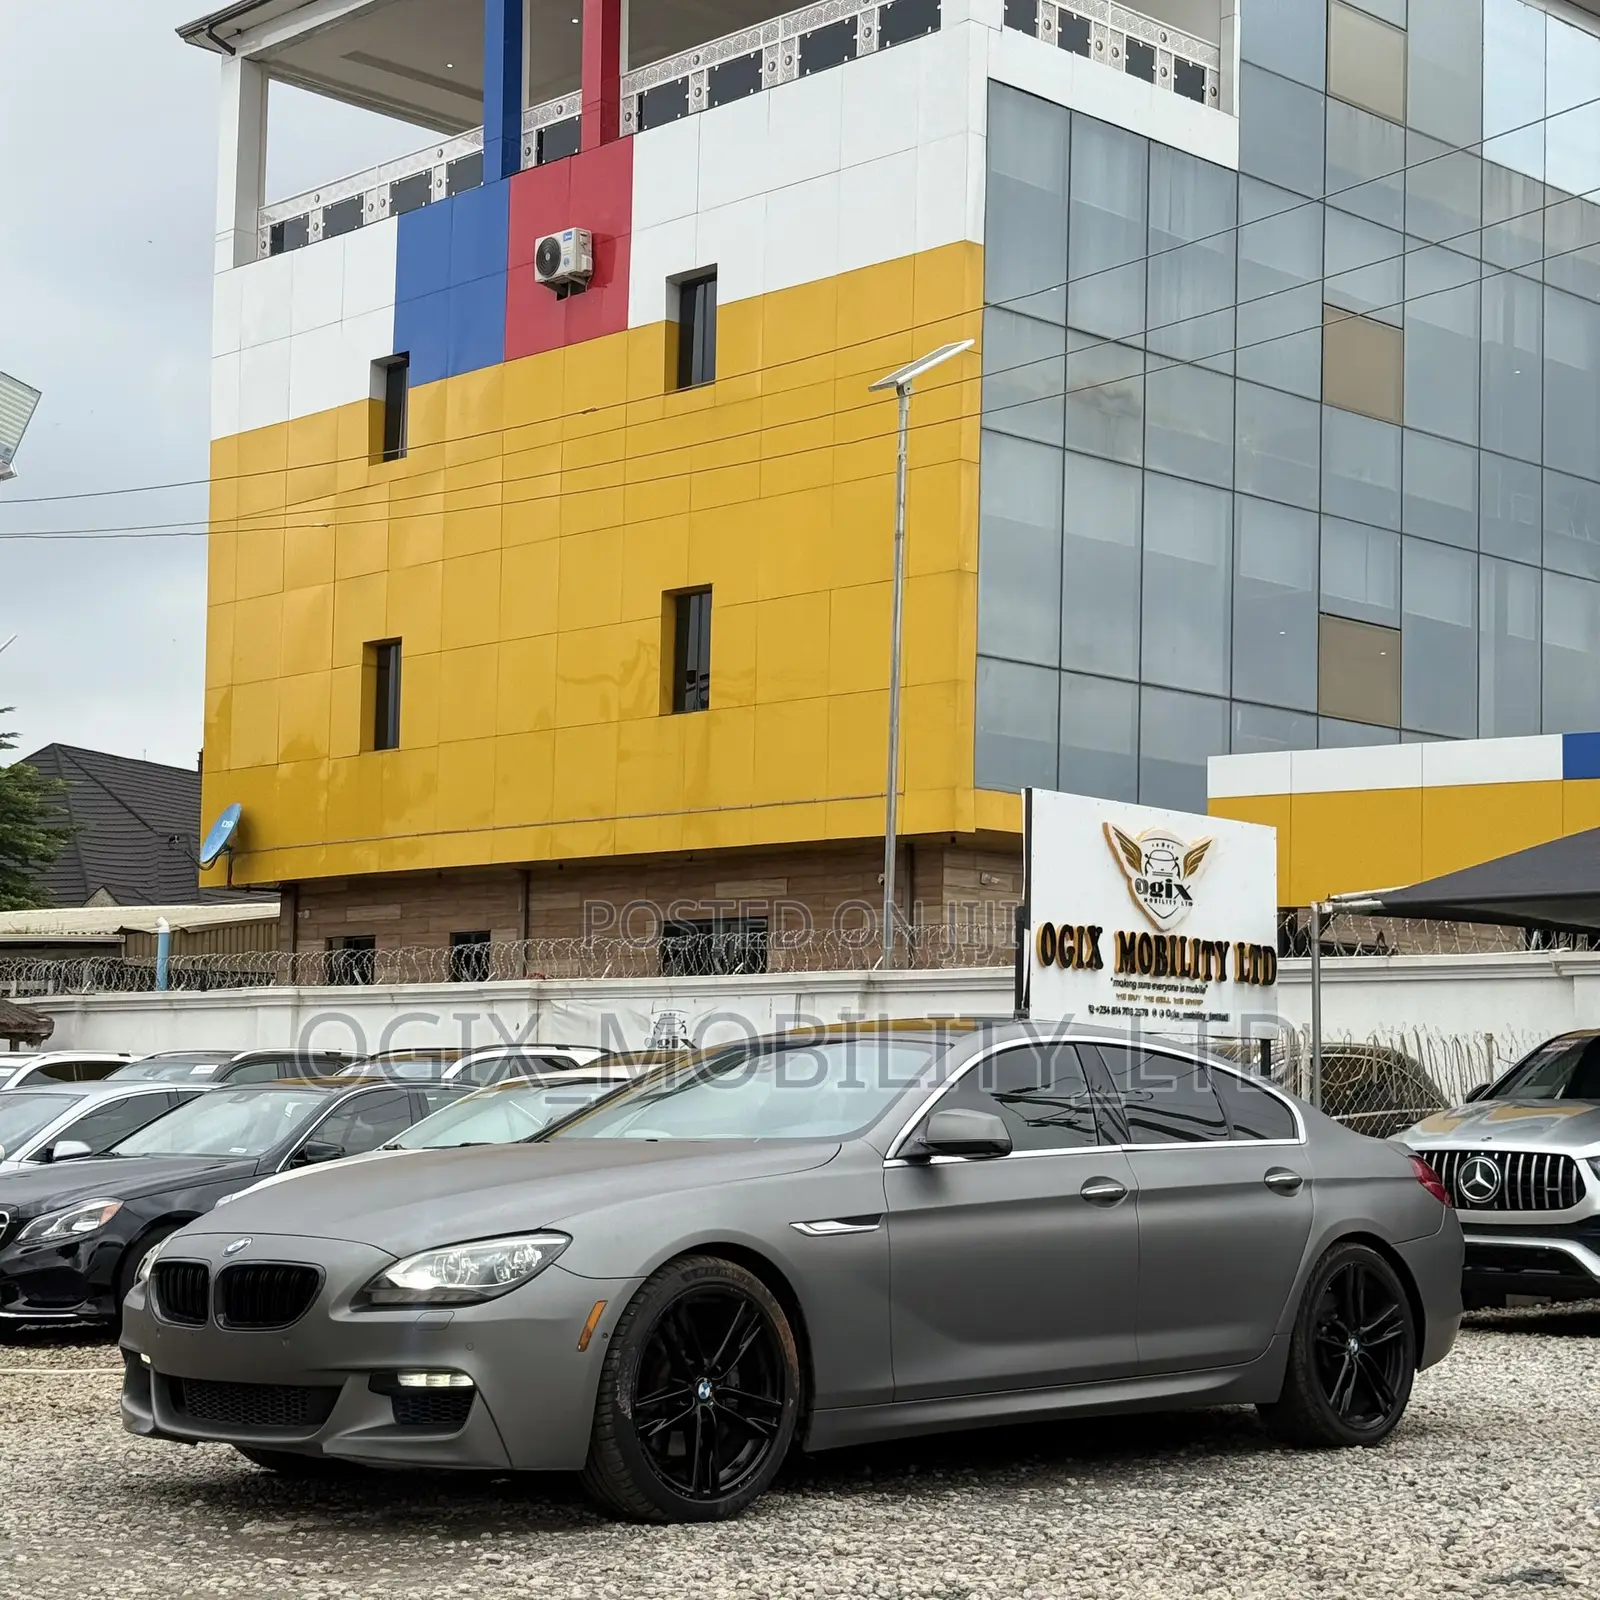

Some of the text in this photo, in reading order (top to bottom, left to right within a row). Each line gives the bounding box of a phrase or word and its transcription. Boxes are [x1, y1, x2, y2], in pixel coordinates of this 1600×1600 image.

[1144, 897, 1177, 906] MOBILITY
[1036, 922, 1277, 986] OGIX MOBILITY LTD
[1151, 982, 1178, 992] everyone
[1179, 983, 1185, 993] is
